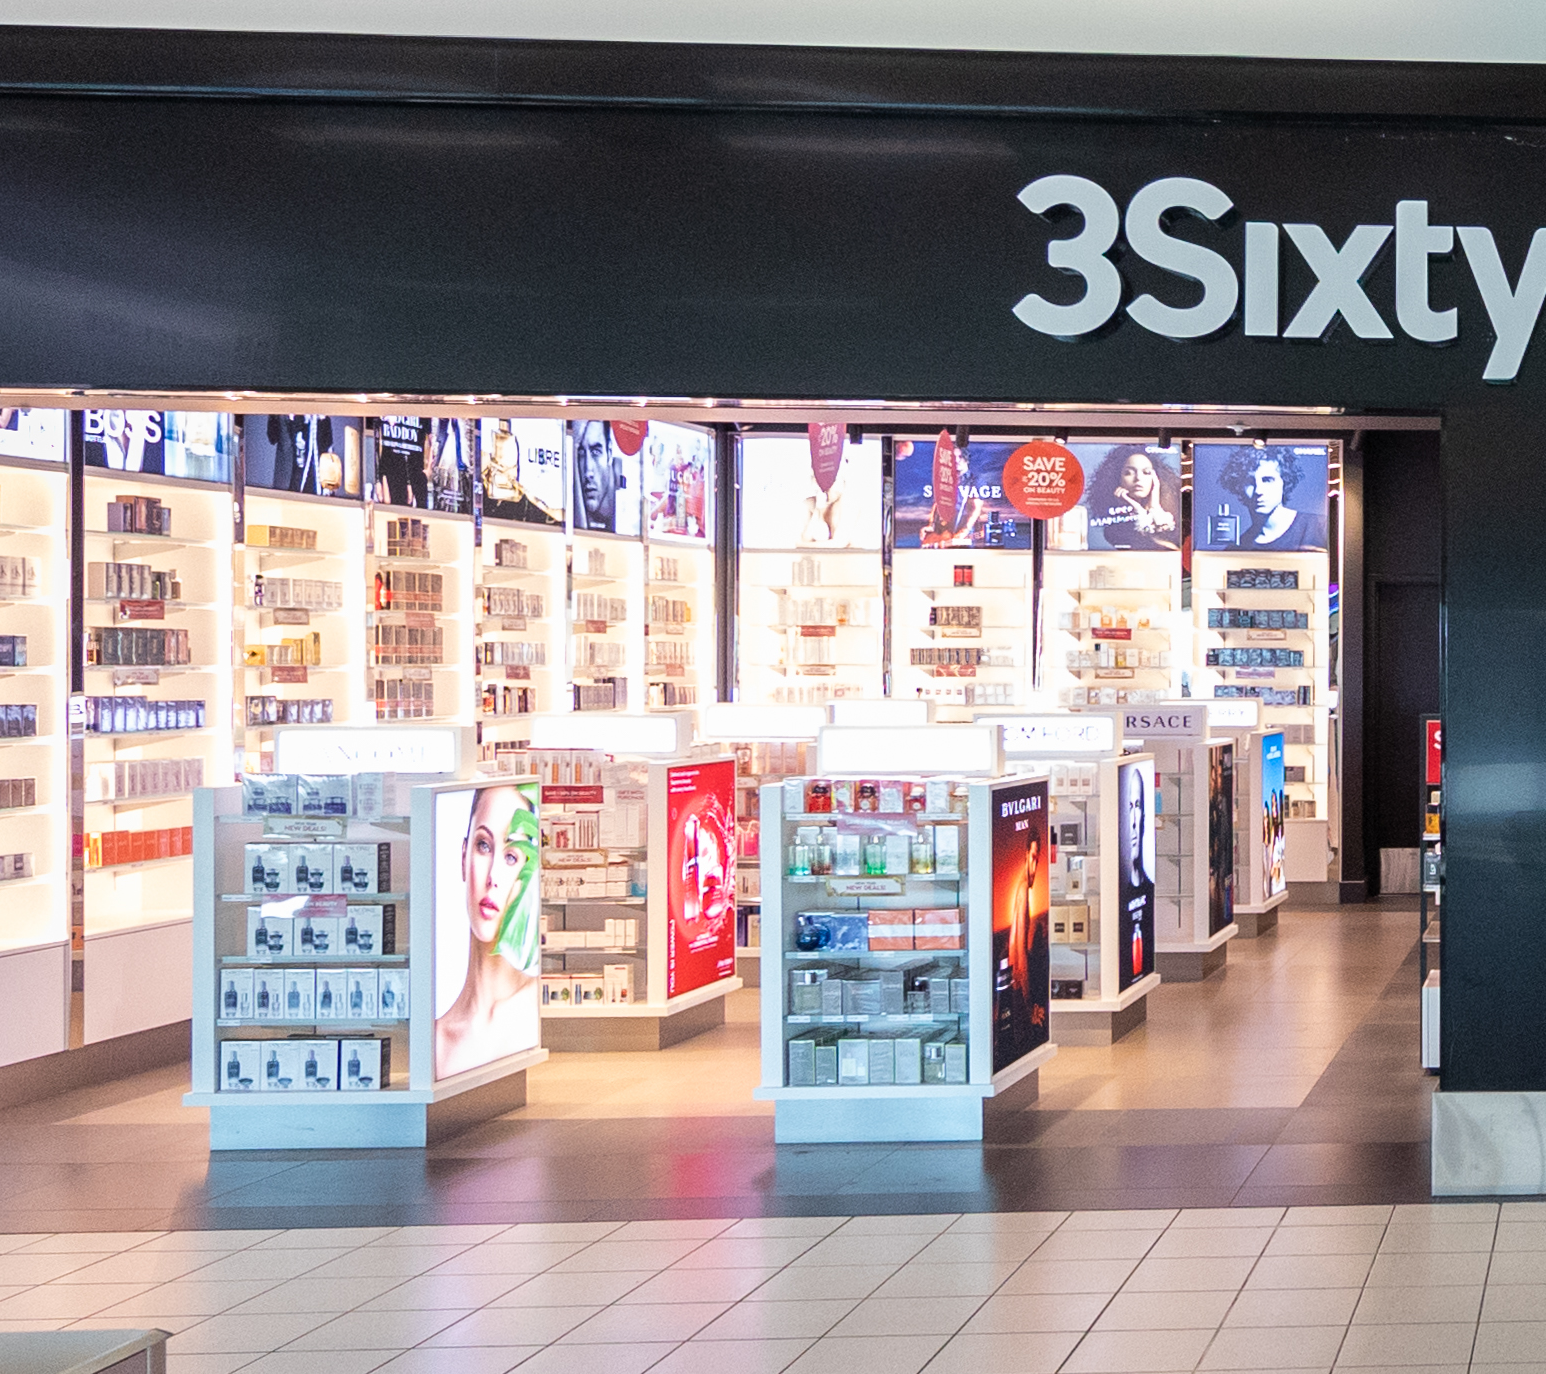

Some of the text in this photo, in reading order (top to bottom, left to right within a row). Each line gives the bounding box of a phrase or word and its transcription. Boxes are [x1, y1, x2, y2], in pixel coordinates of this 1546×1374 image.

[528, 448, 561, 468] LIBRE
[1023, 456, 1066, 472] SAVE
[1027, 472, 1066, 487] 20%
[1125, 714, 1193, 729] RSACE
[1000, 795, 1042, 818] BVLGARI
